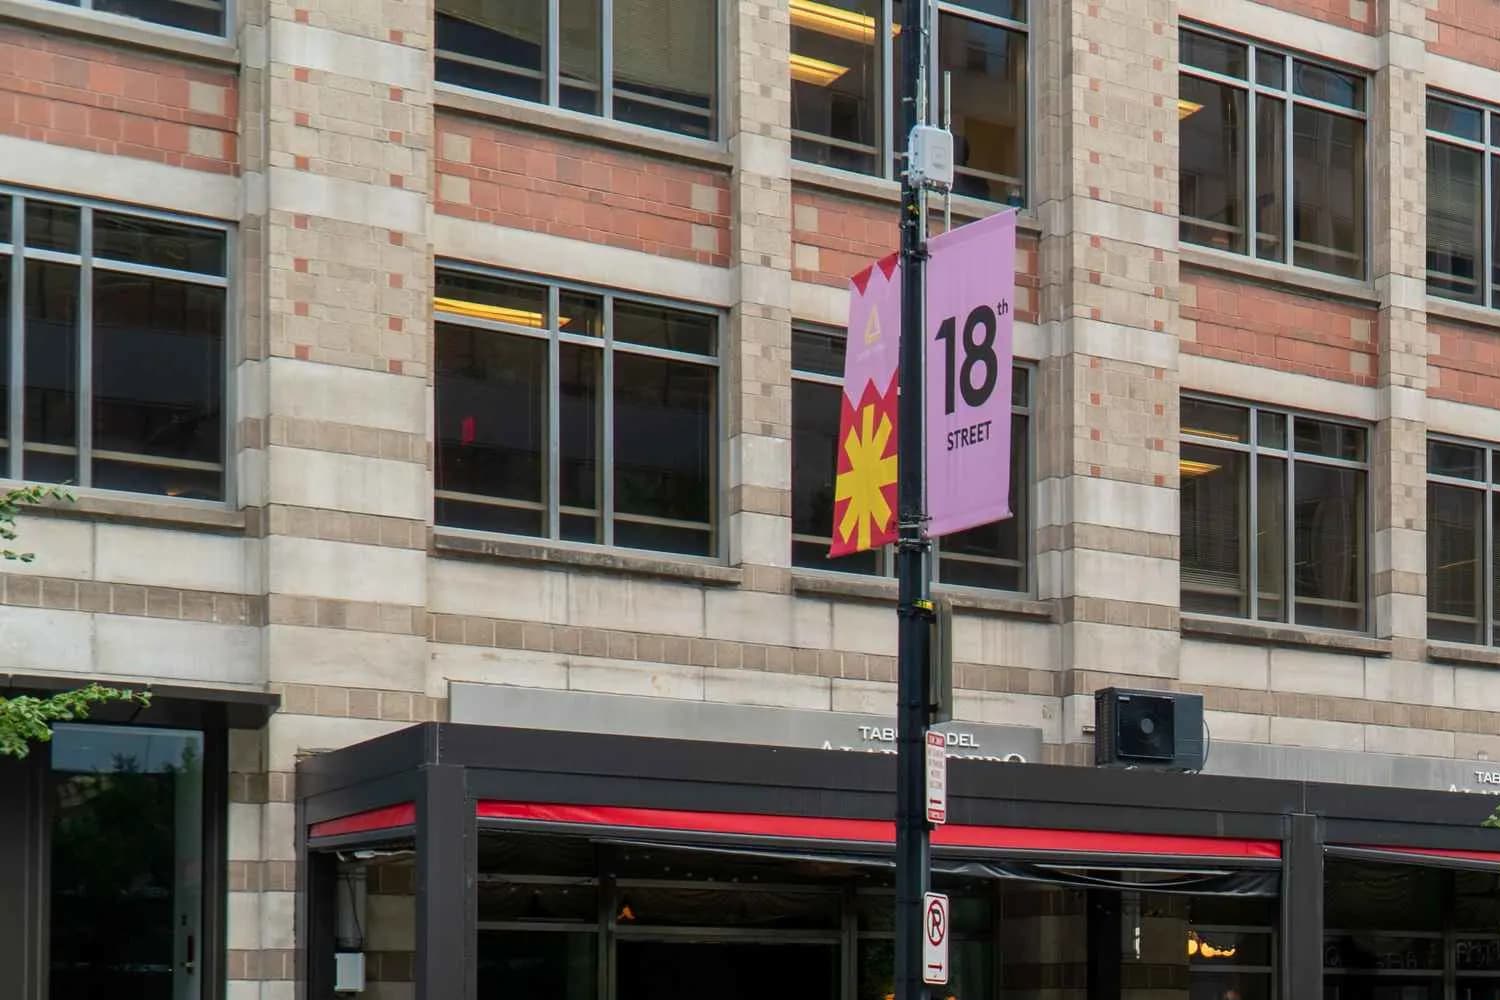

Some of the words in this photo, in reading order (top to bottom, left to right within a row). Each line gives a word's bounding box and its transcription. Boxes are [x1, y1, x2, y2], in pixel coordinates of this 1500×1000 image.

[934, 299, 1008, 416] 18th
[947, 421, 992, 451] STREET
[946, 733, 980, 748] DEL
